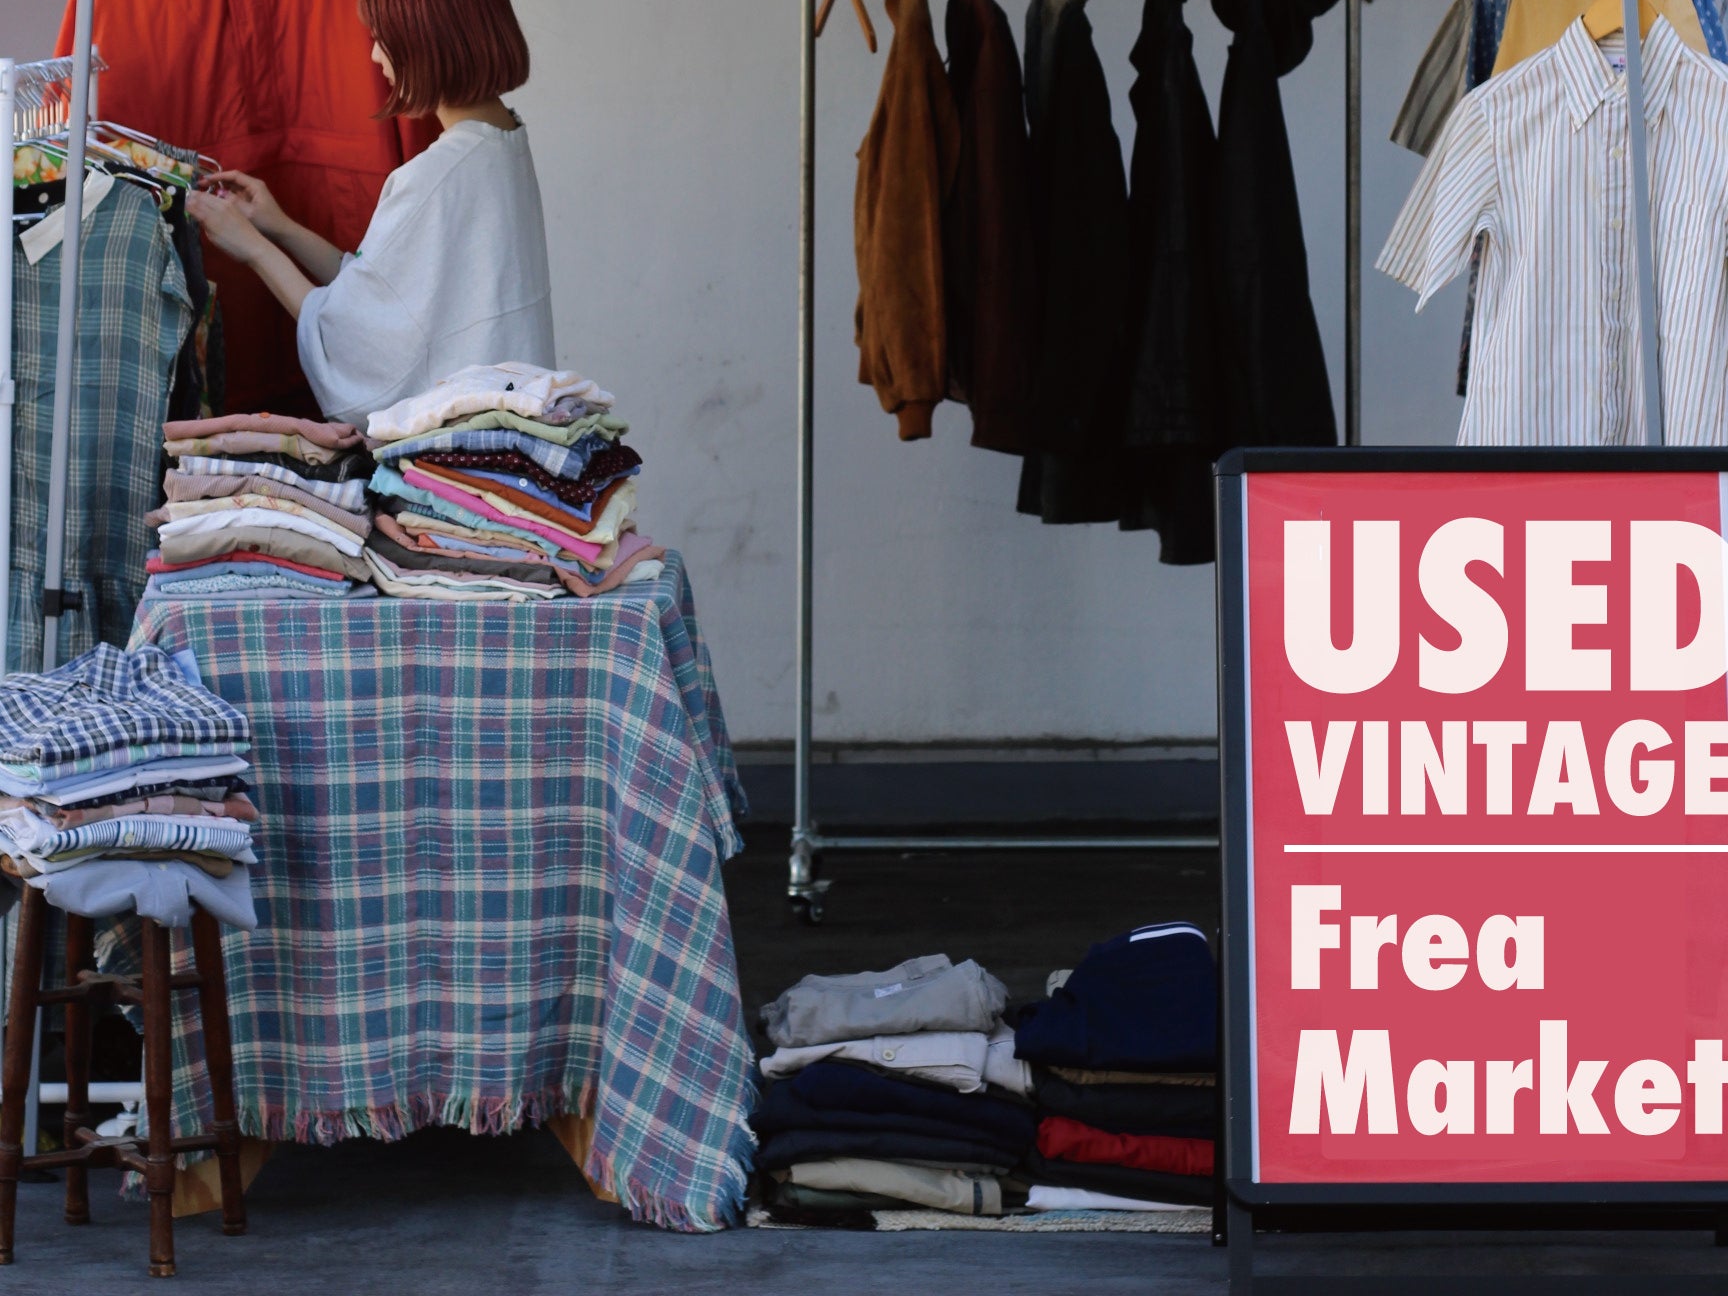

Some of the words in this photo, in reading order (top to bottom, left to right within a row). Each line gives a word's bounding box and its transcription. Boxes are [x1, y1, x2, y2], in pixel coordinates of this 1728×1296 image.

[1284, 517, 1728, 694] USED
[1284, 719, 1728, 817] VINTAGE
[1291, 885, 1544, 991] Frea
[1289, 1019, 1728, 1136] Market
